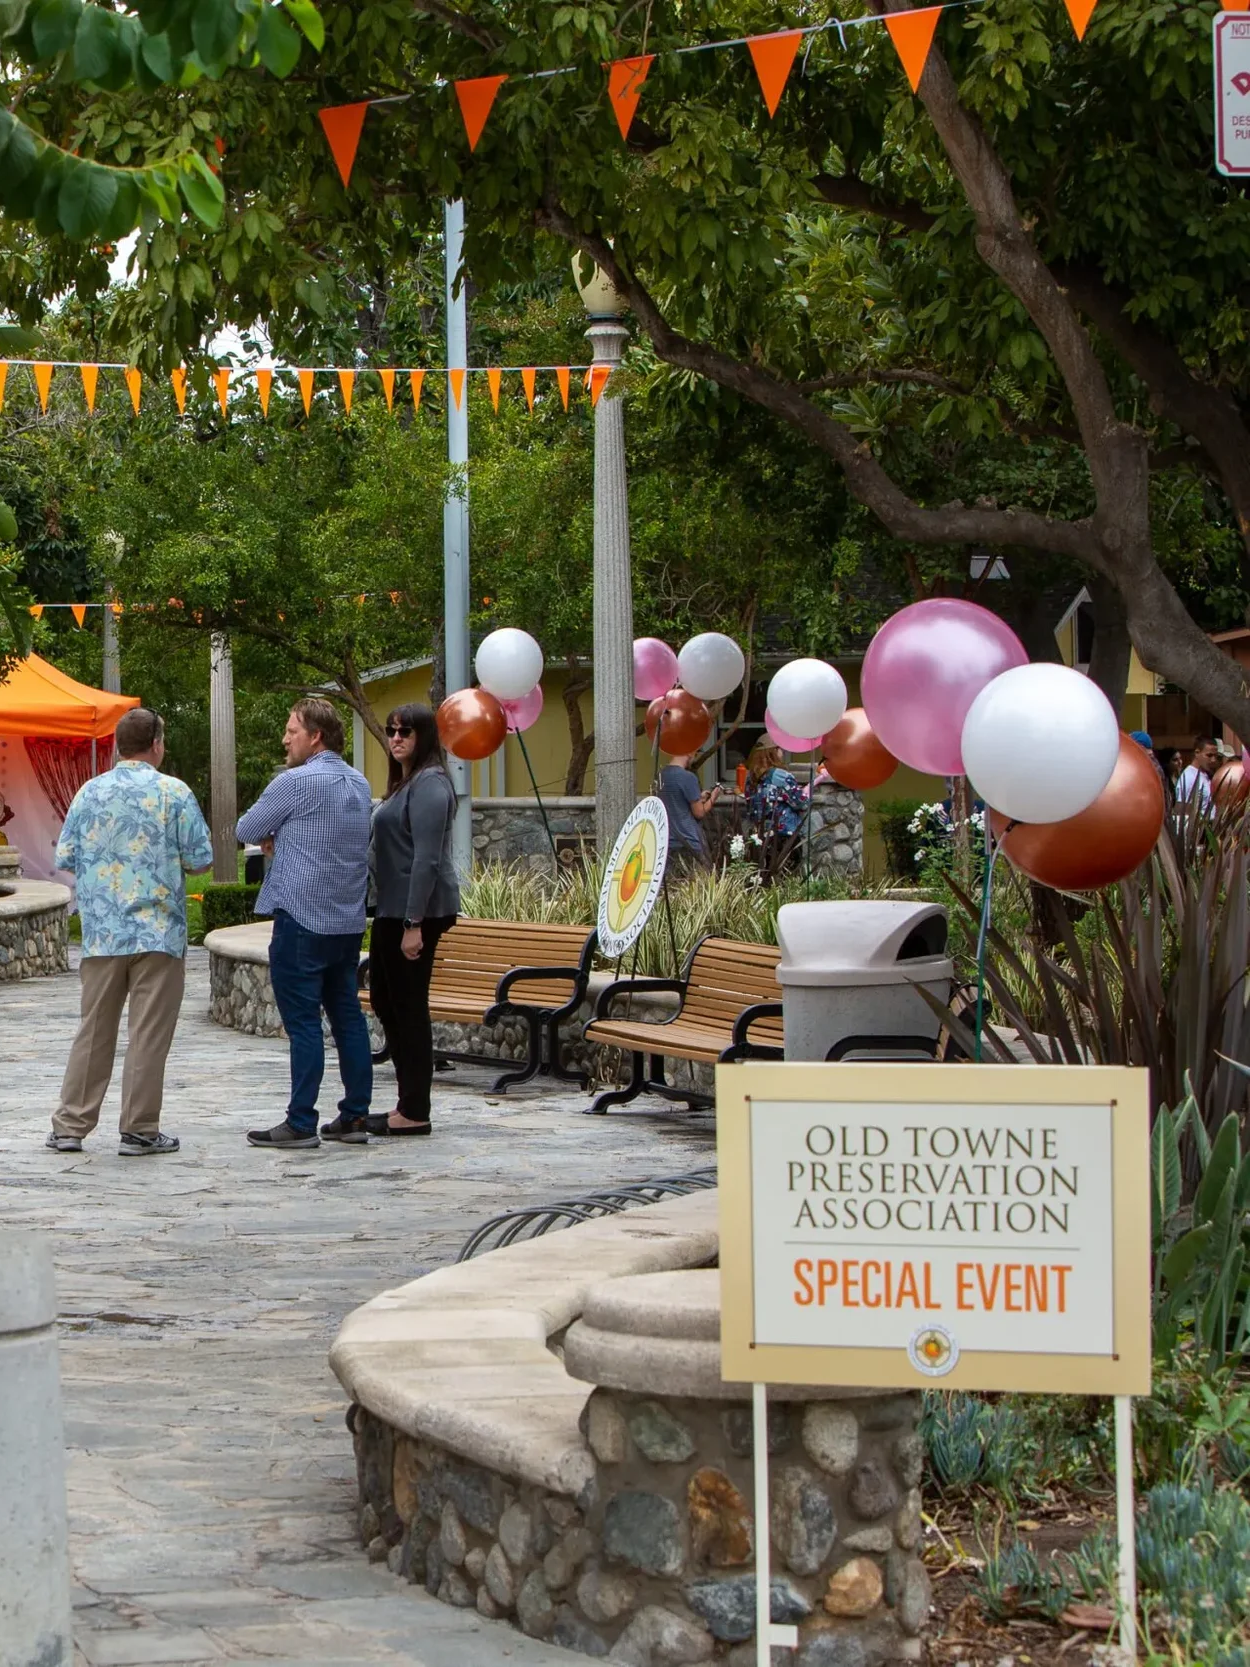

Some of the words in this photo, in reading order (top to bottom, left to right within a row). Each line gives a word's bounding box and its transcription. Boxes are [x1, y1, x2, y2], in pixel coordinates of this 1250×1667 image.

[1235, 129, 1250, 140] PU
[805, 1124, 889, 1158] OLD
[903, 1126, 1059, 1160] TOWNE
[786, 1161, 1080, 1197] PRESERVATION
[792, 1197, 1070, 1234] ASSOCIATION
[793, 1258, 941, 1310] SPECIAL
[956, 1262, 1073, 1313] EVENT
